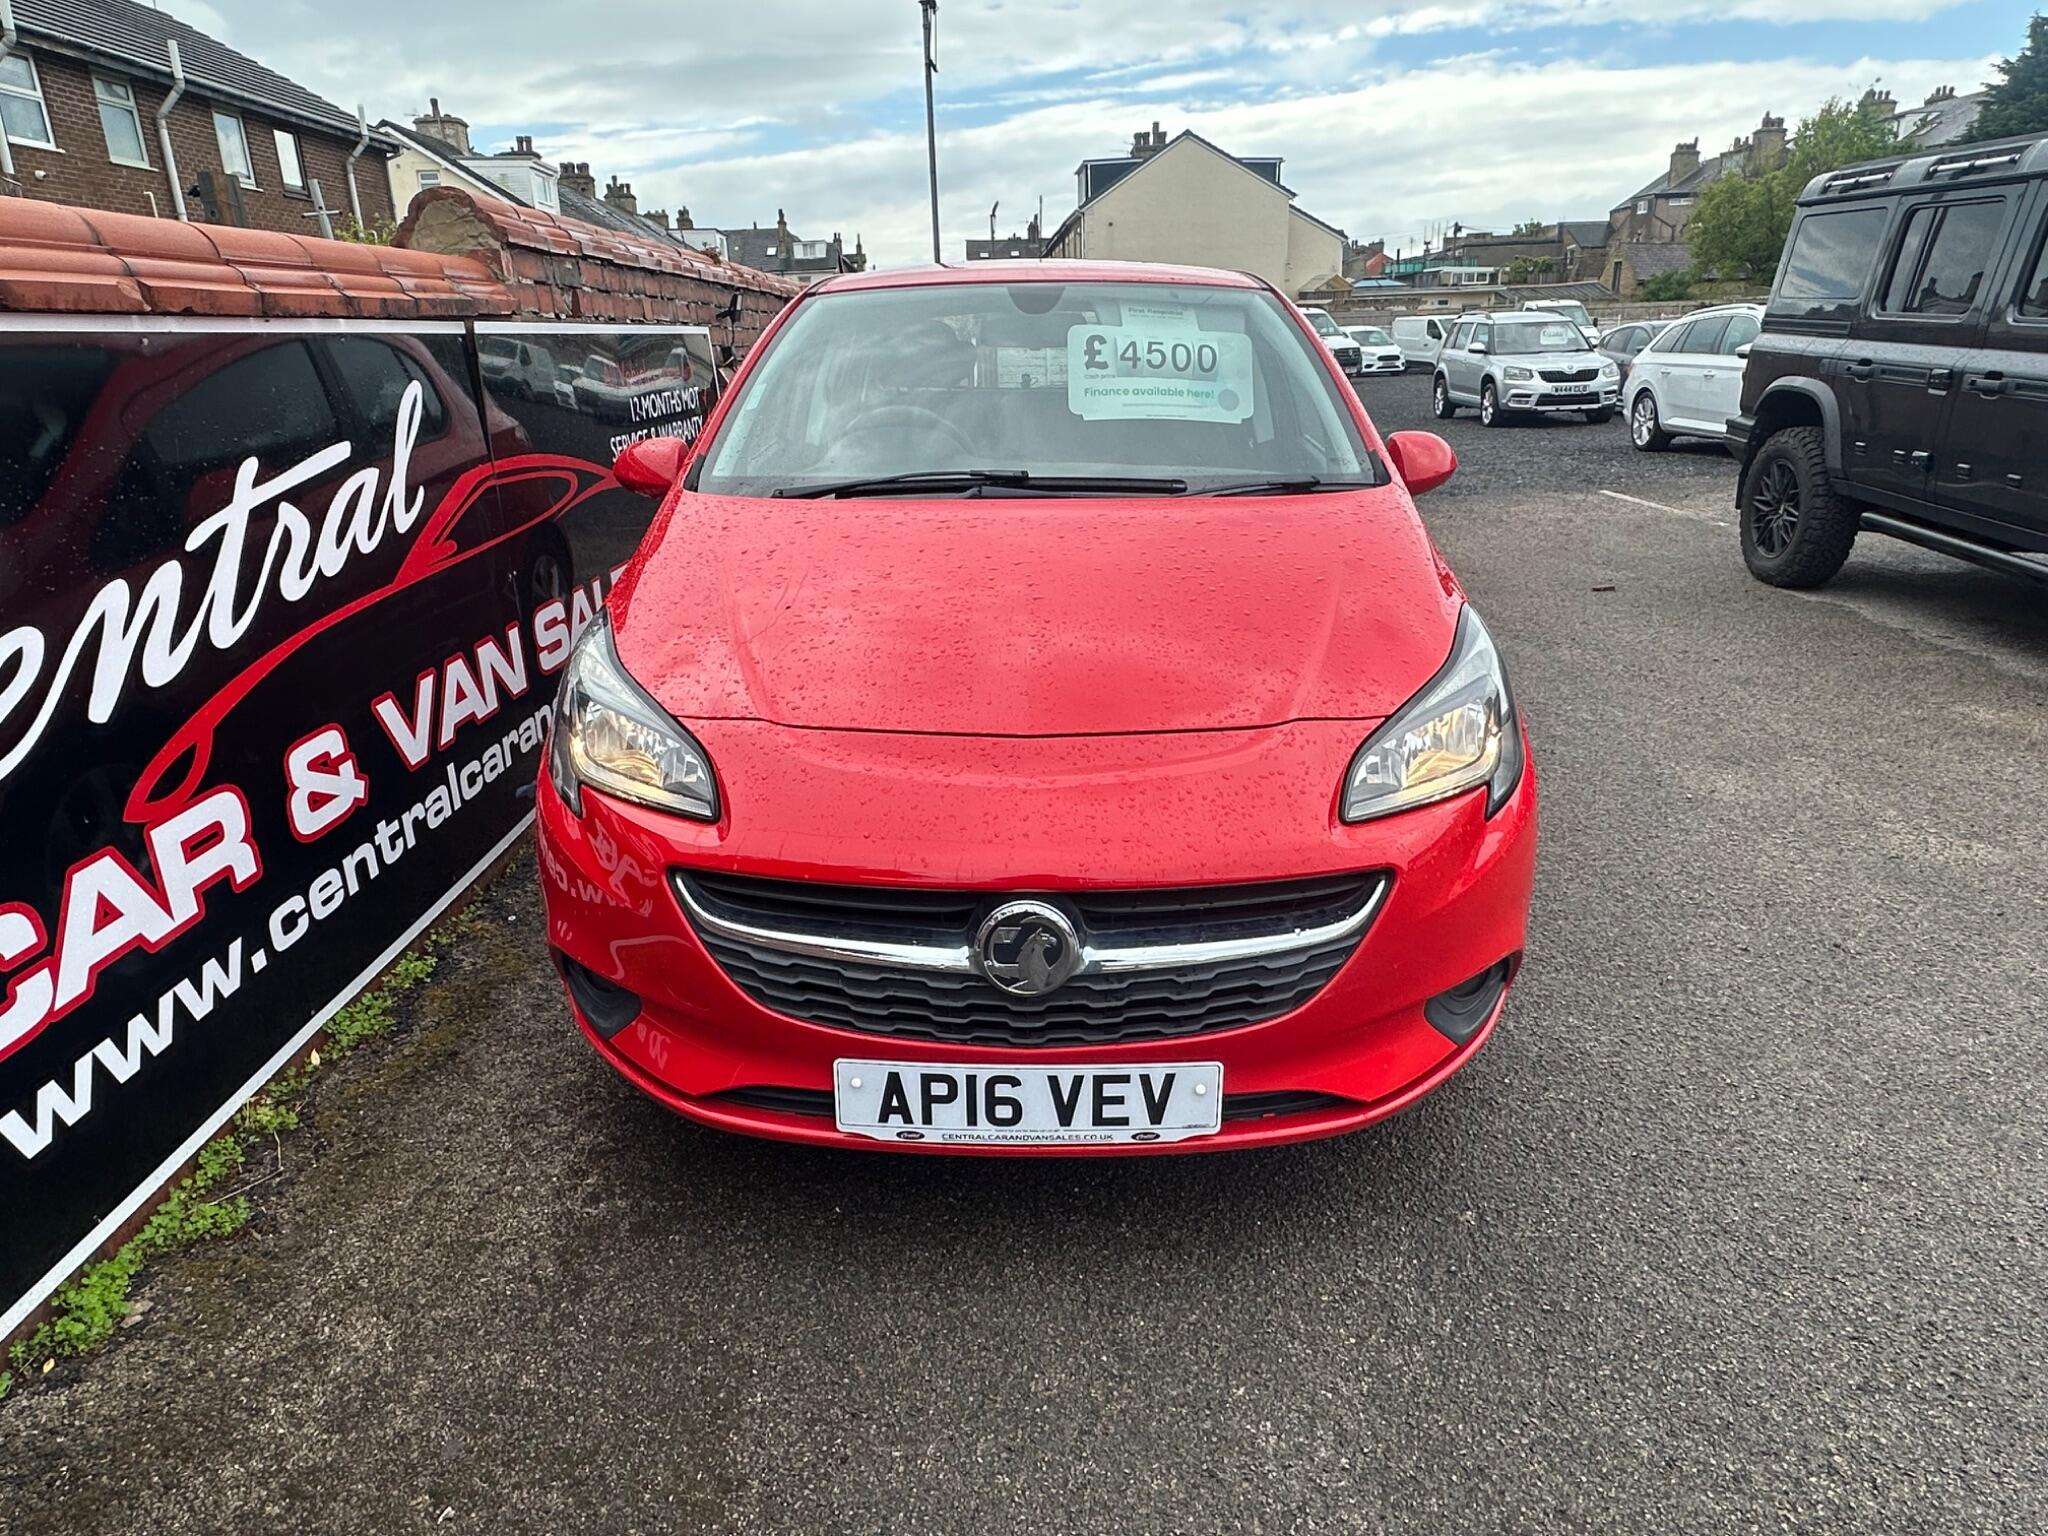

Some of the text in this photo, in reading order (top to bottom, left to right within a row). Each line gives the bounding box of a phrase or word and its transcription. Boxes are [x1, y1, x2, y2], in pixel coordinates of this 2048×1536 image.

[641, 390, 681, 420] MONTHS
[681, 386, 700, 411] MOT
[1084, 387, 1215, 399] Finance available here!
[286, 726, 367, 839] &
[372, 622, 529, 772] VAN
[877, 1070, 1177, 1128] AP16 VEV
[941, 1133, 1114, 1141] CENTRALCARANDVANSALES.CO.UK
